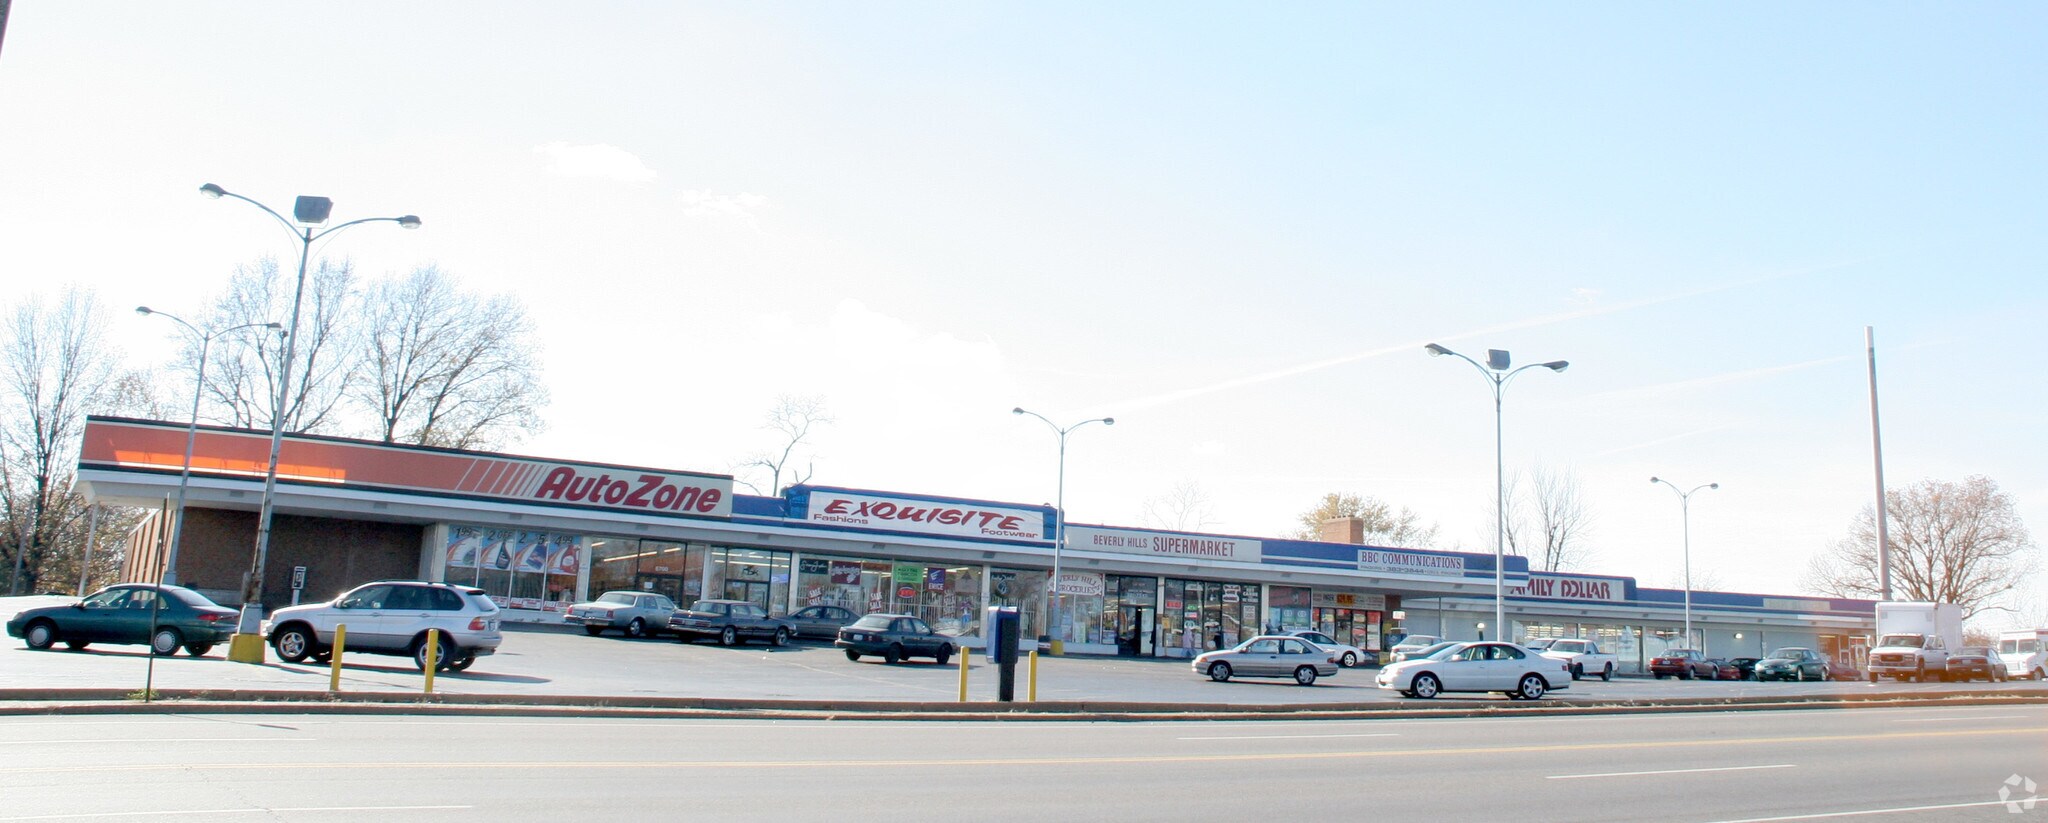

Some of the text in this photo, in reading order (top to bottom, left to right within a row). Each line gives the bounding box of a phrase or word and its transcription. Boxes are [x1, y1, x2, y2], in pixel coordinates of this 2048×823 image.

[534, 466, 722, 513] AutoZone
[814, 513, 869, 525] Fashions
[824, 499, 1024, 530] EXQUISITE
[981, 527, 1038, 539] Footwear
[1093, 534, 1235, 557] BEVERLY HILLS SUPERMARKET
[1361, 551, 1462, 569] BBC COMMUNICATIONS
[1510, 578, 1611, 599] AMILY DOLLAR
